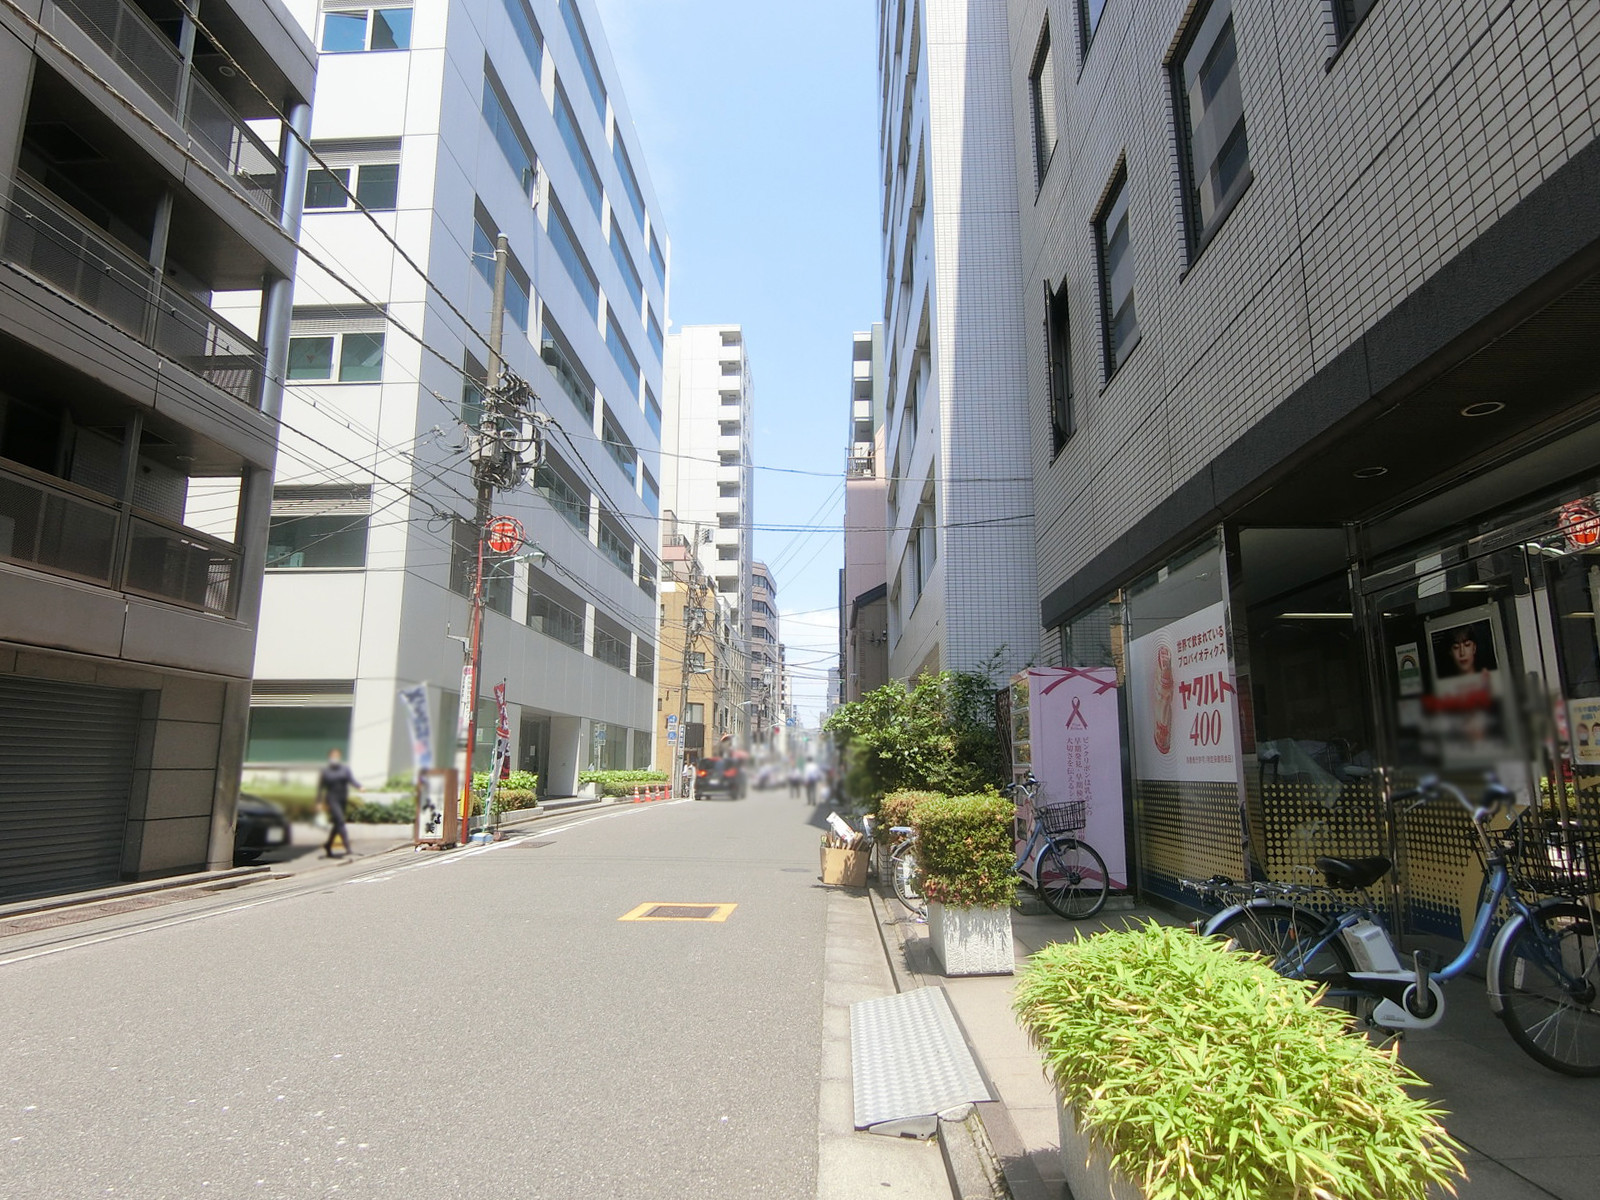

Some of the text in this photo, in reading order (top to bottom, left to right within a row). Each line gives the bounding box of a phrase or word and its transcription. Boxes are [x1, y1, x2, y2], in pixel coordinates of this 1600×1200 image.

[1176, 625, 1225, 654] 世界で飲まれている
[1178, 642, 1226, 668] プロバイオティクス
[1178, 671, 1236, 710] ヤクルト
[1189, 709, 1222, 746] 400
